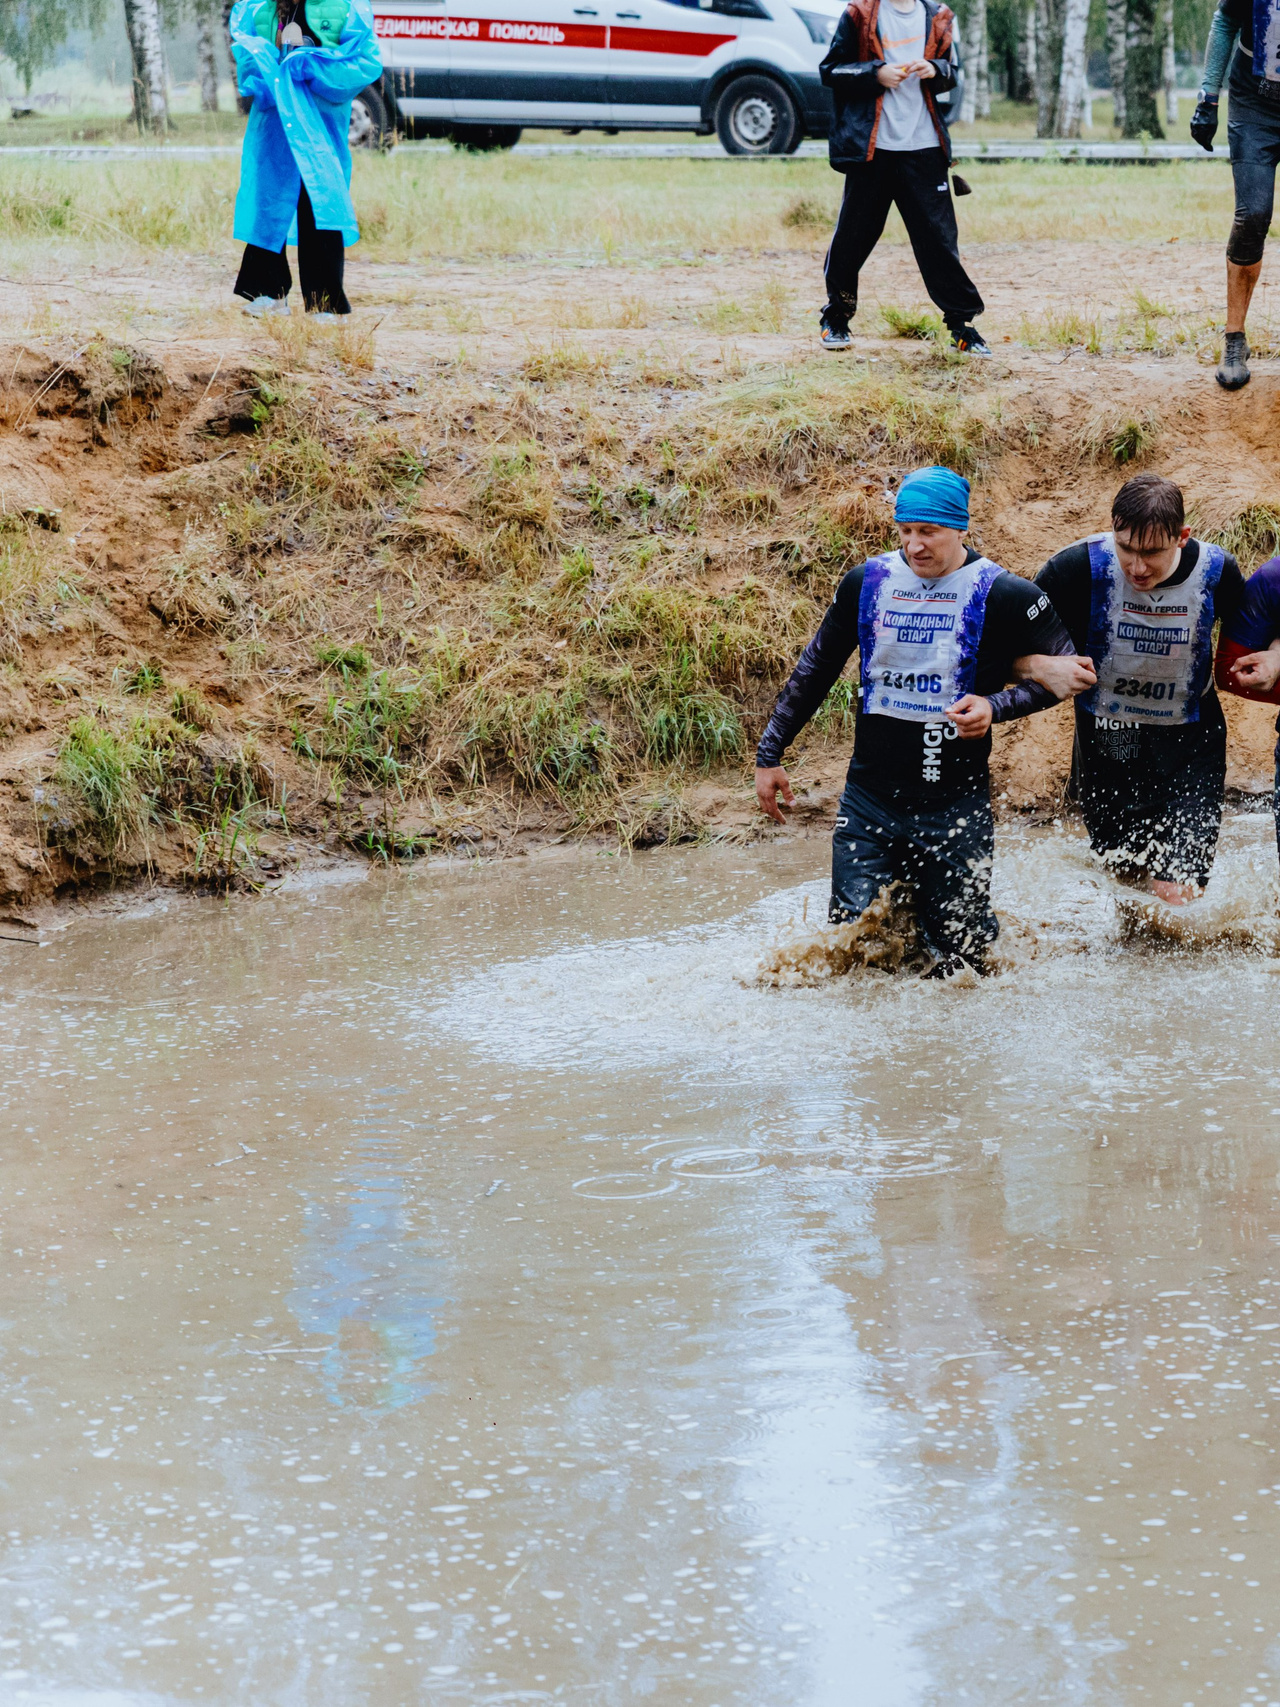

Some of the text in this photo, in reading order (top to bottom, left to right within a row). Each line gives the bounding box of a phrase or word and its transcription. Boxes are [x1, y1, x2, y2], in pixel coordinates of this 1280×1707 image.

[374, 18, 565, 44] ЕДИЦИНСКАЯ ПОМОЩЬ
[892, 589, 958, 600] ГОНКА ГЕРОЕВ
[1123, 601, 1152, 613] ГОНКА
[884, 612, 954, 630] КОМАНДНЫЙ
[899, 628, 933, 642] СТАРТ
[1119, 625, 1188, 643] КОМАНДНЫЙ
[1136, 641, 1169, 655] СТАРТ
[881, 670, 942, 694] 23406
[1113, 678, 1176, 700] 23401
[892, 700, 942, 713] ГАЗПРОМБАНК
[1124, 706, 1174, 717] ГАЗПРОМБАНК
[1102, 744, 1141, 760] GNT
